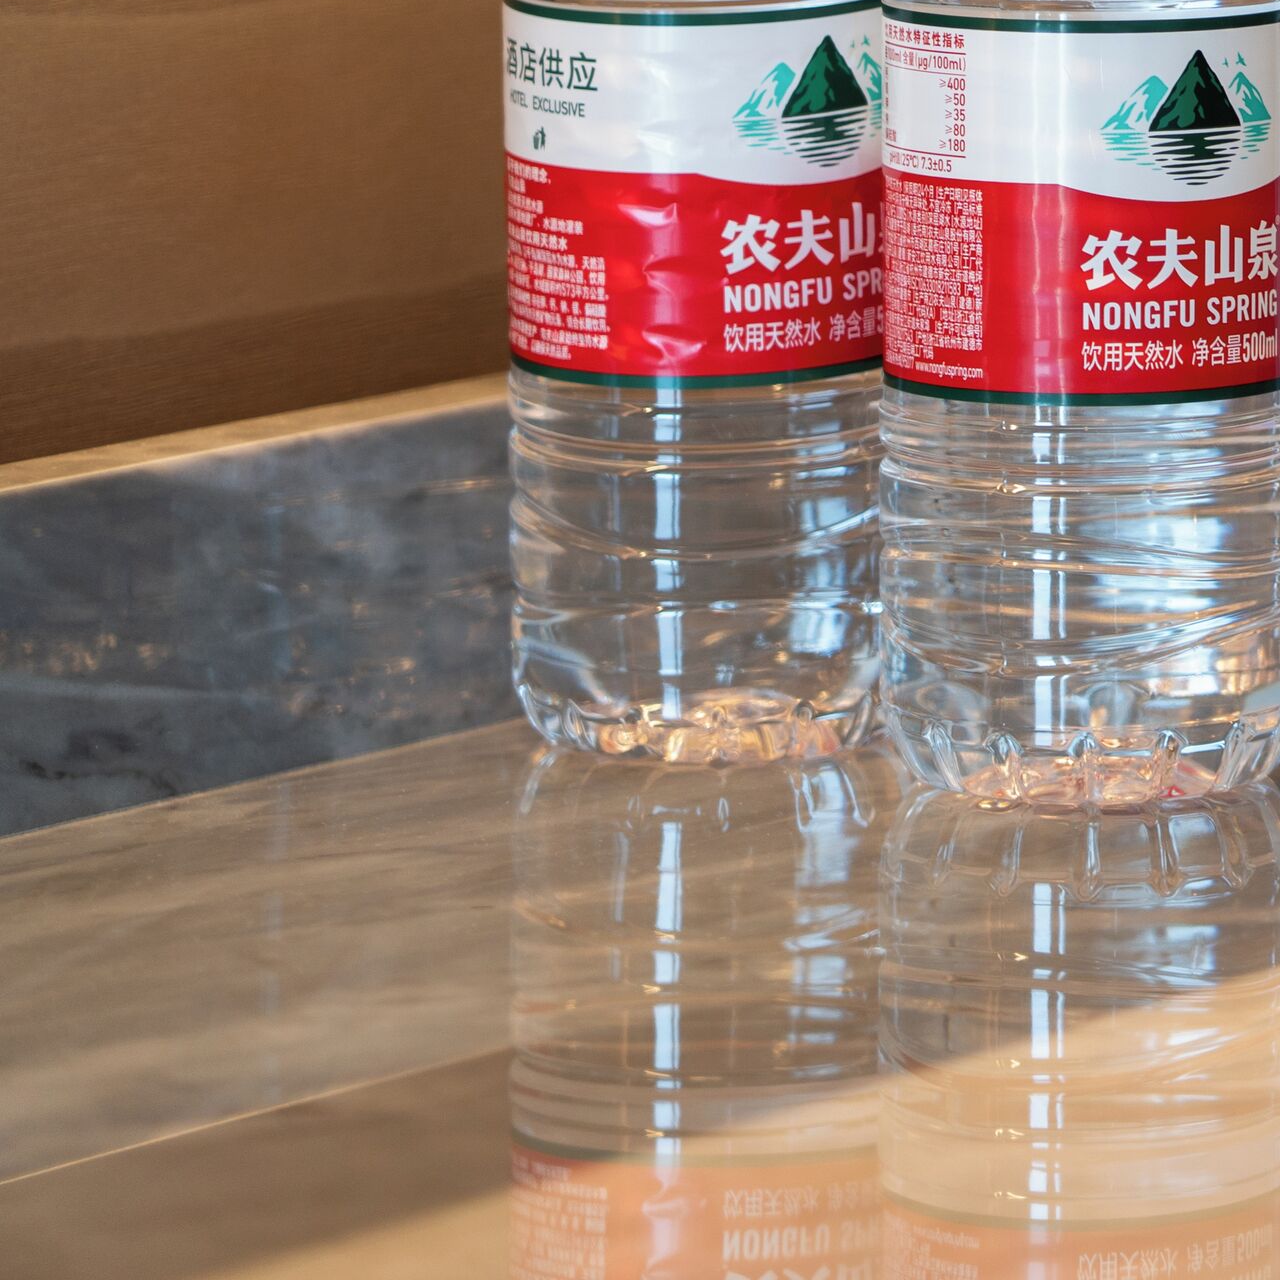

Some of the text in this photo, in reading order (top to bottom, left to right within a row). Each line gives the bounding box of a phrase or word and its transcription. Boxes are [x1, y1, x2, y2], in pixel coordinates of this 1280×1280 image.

[507, 37, 598, 91] 酒店供应
[532, 95, 586, 118] EXCLUSIVE
[921, 156, 952, 172] 7.3±0.5
[720, 202, 883, 275] 农夫山
[1080, 220, 1279, 291] 农夫山泉
[724, 276, 832, 313] NONGFU
[1082, 289, 1278, 330] NONGFU SPRING
[724, 316, 821, 353] 饮用天然水
[1081, 328, 1278, 371] 饮用天然水 净含量500ml
